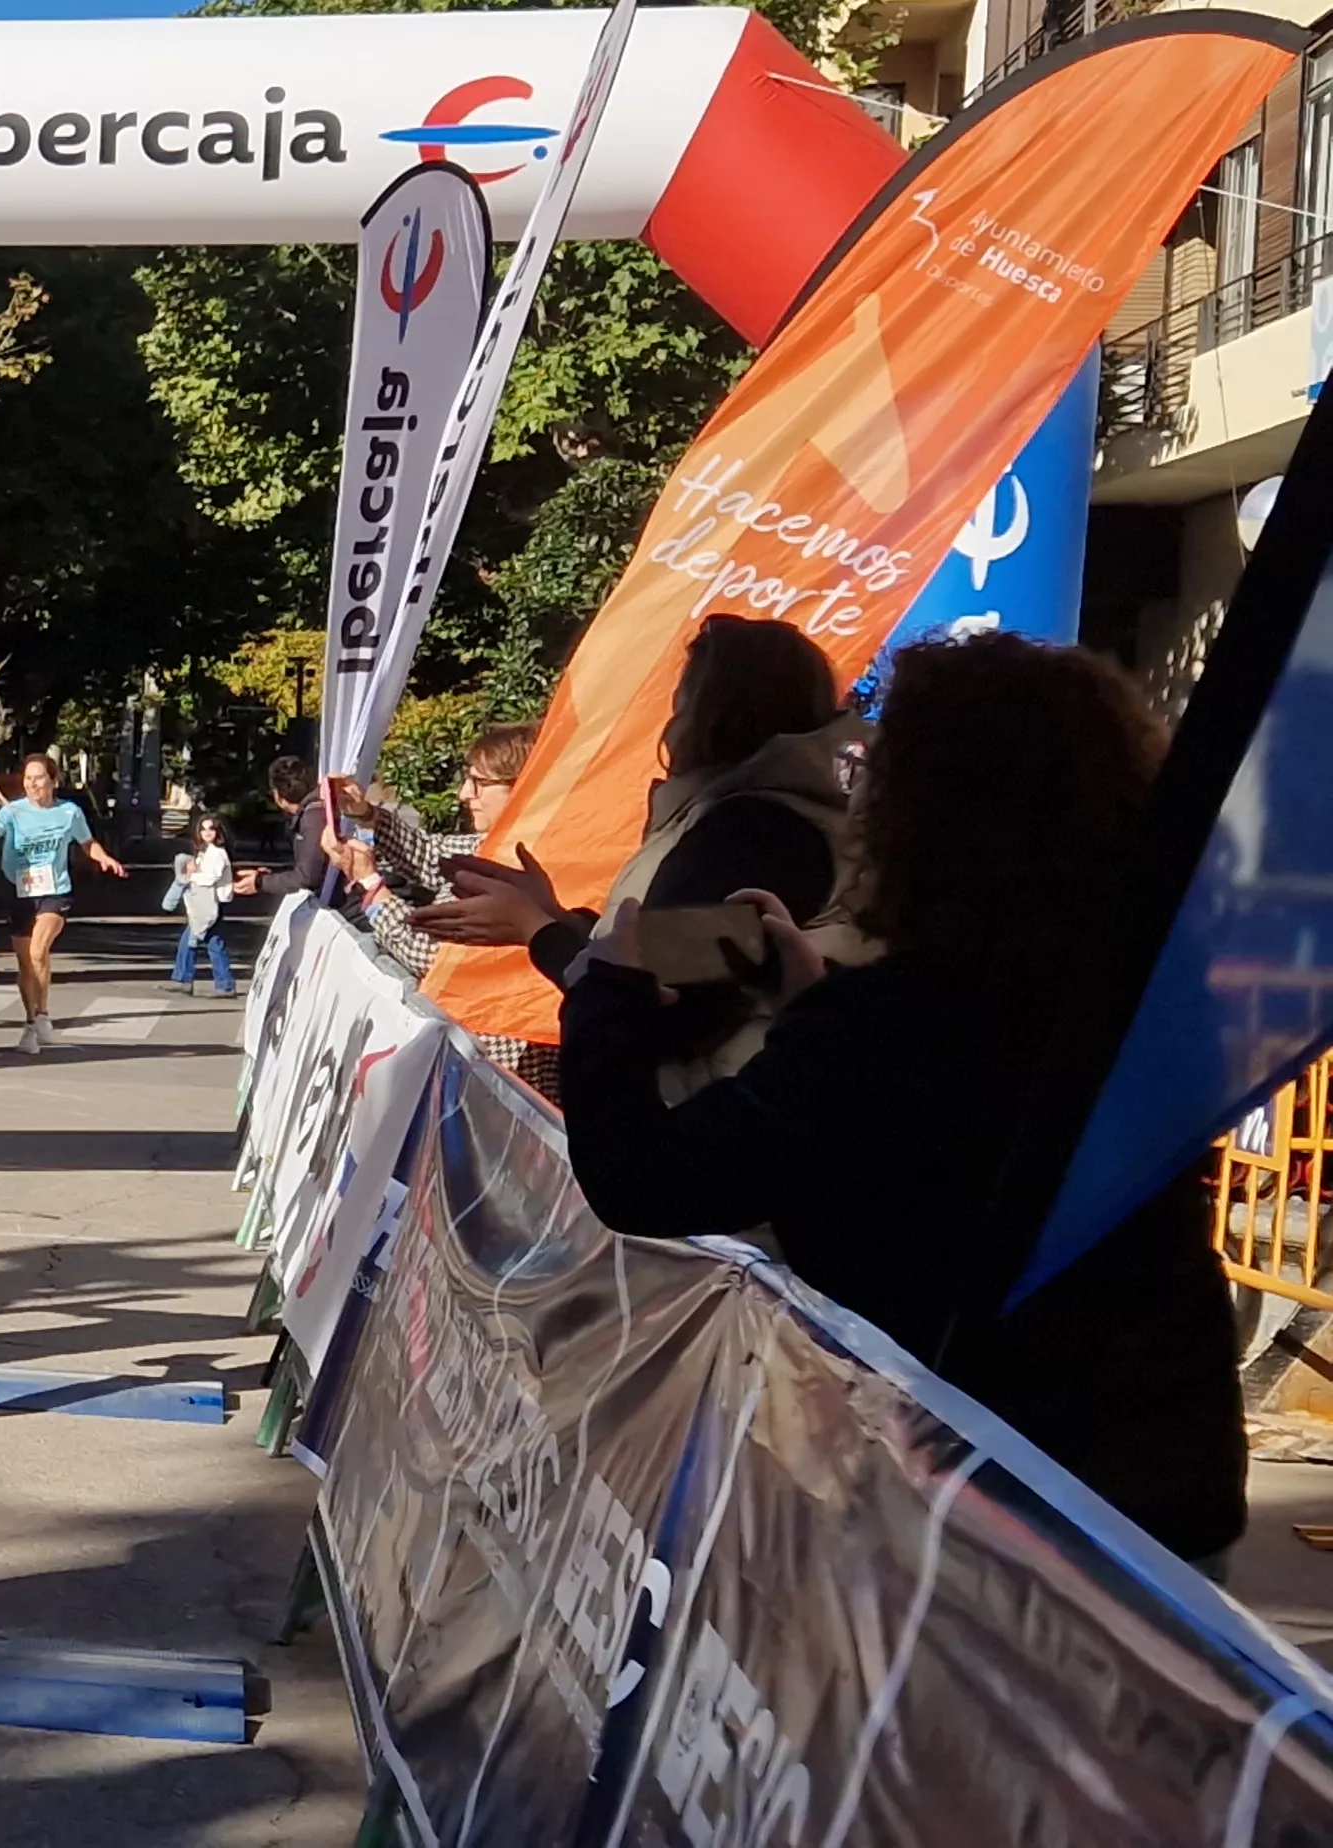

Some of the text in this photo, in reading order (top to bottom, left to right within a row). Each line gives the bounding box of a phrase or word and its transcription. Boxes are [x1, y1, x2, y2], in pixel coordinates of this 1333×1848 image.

[949, 233, 1063, 304] de Huesca
[650, 516, 863, 637] deporte
[673, 453, 913, 592] Hacemos
